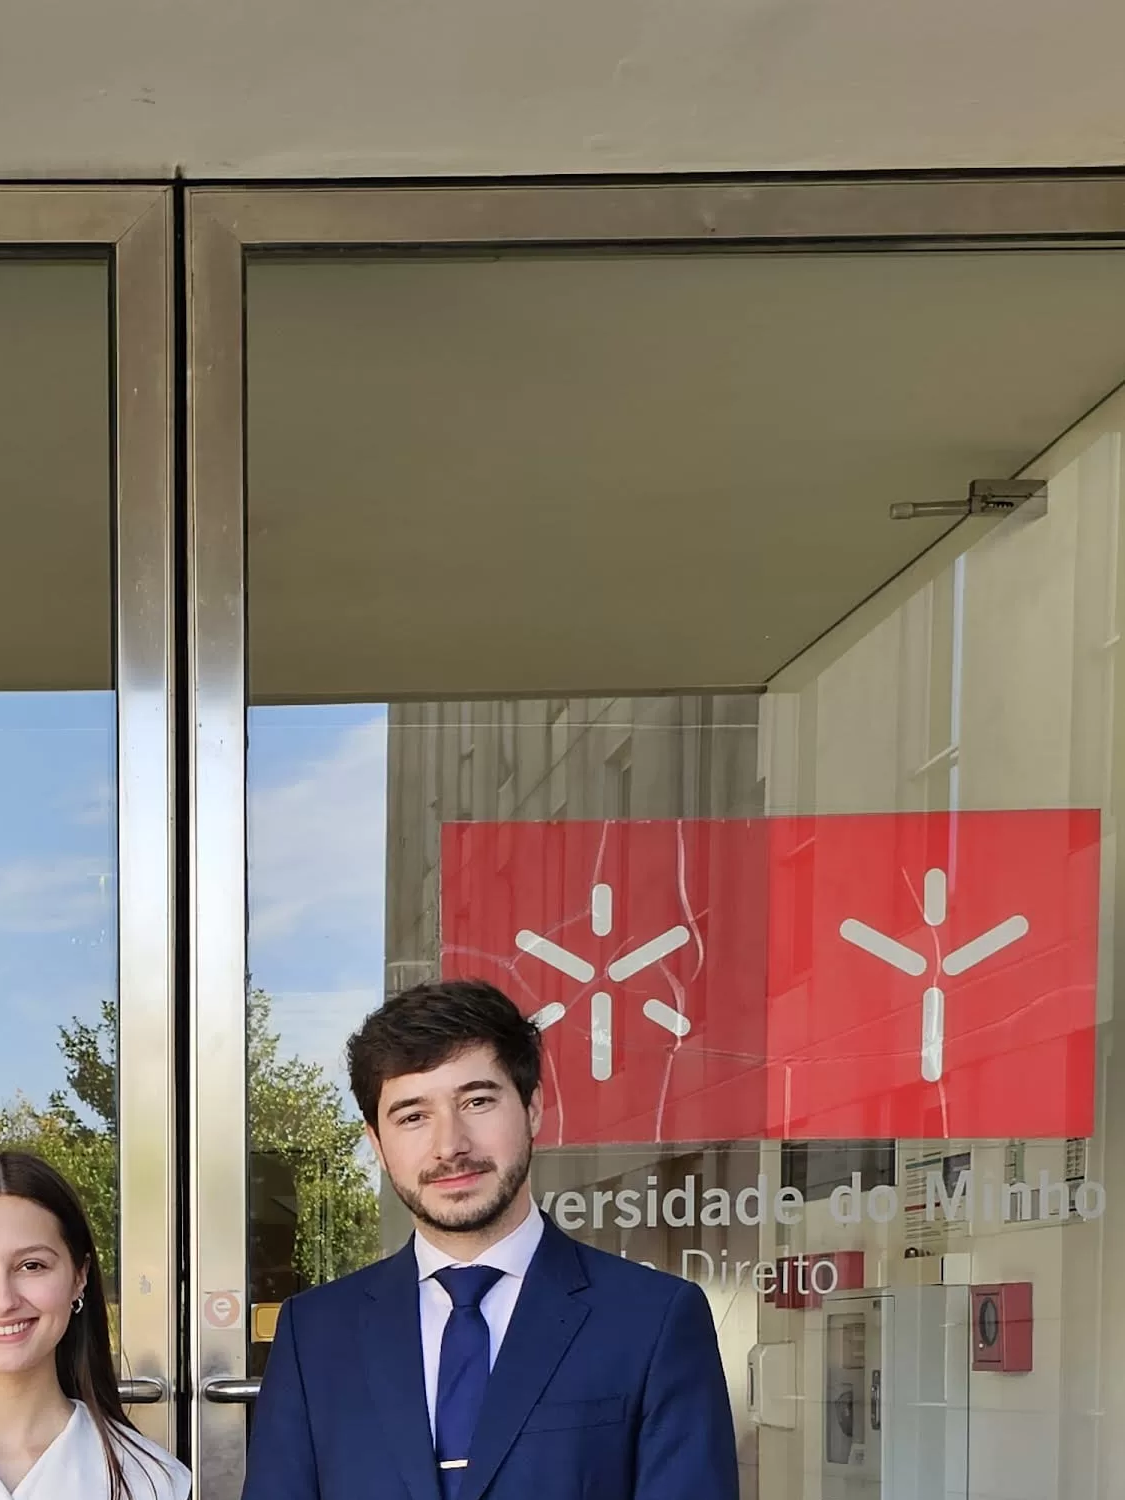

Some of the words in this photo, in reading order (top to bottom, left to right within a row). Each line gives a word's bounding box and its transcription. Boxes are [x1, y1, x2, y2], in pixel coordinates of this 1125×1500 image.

[828, 1171, 899, 1224] do
[926, 1169, 1107, 1222] Minho
[681, 1248, 839, 1295] Direito
